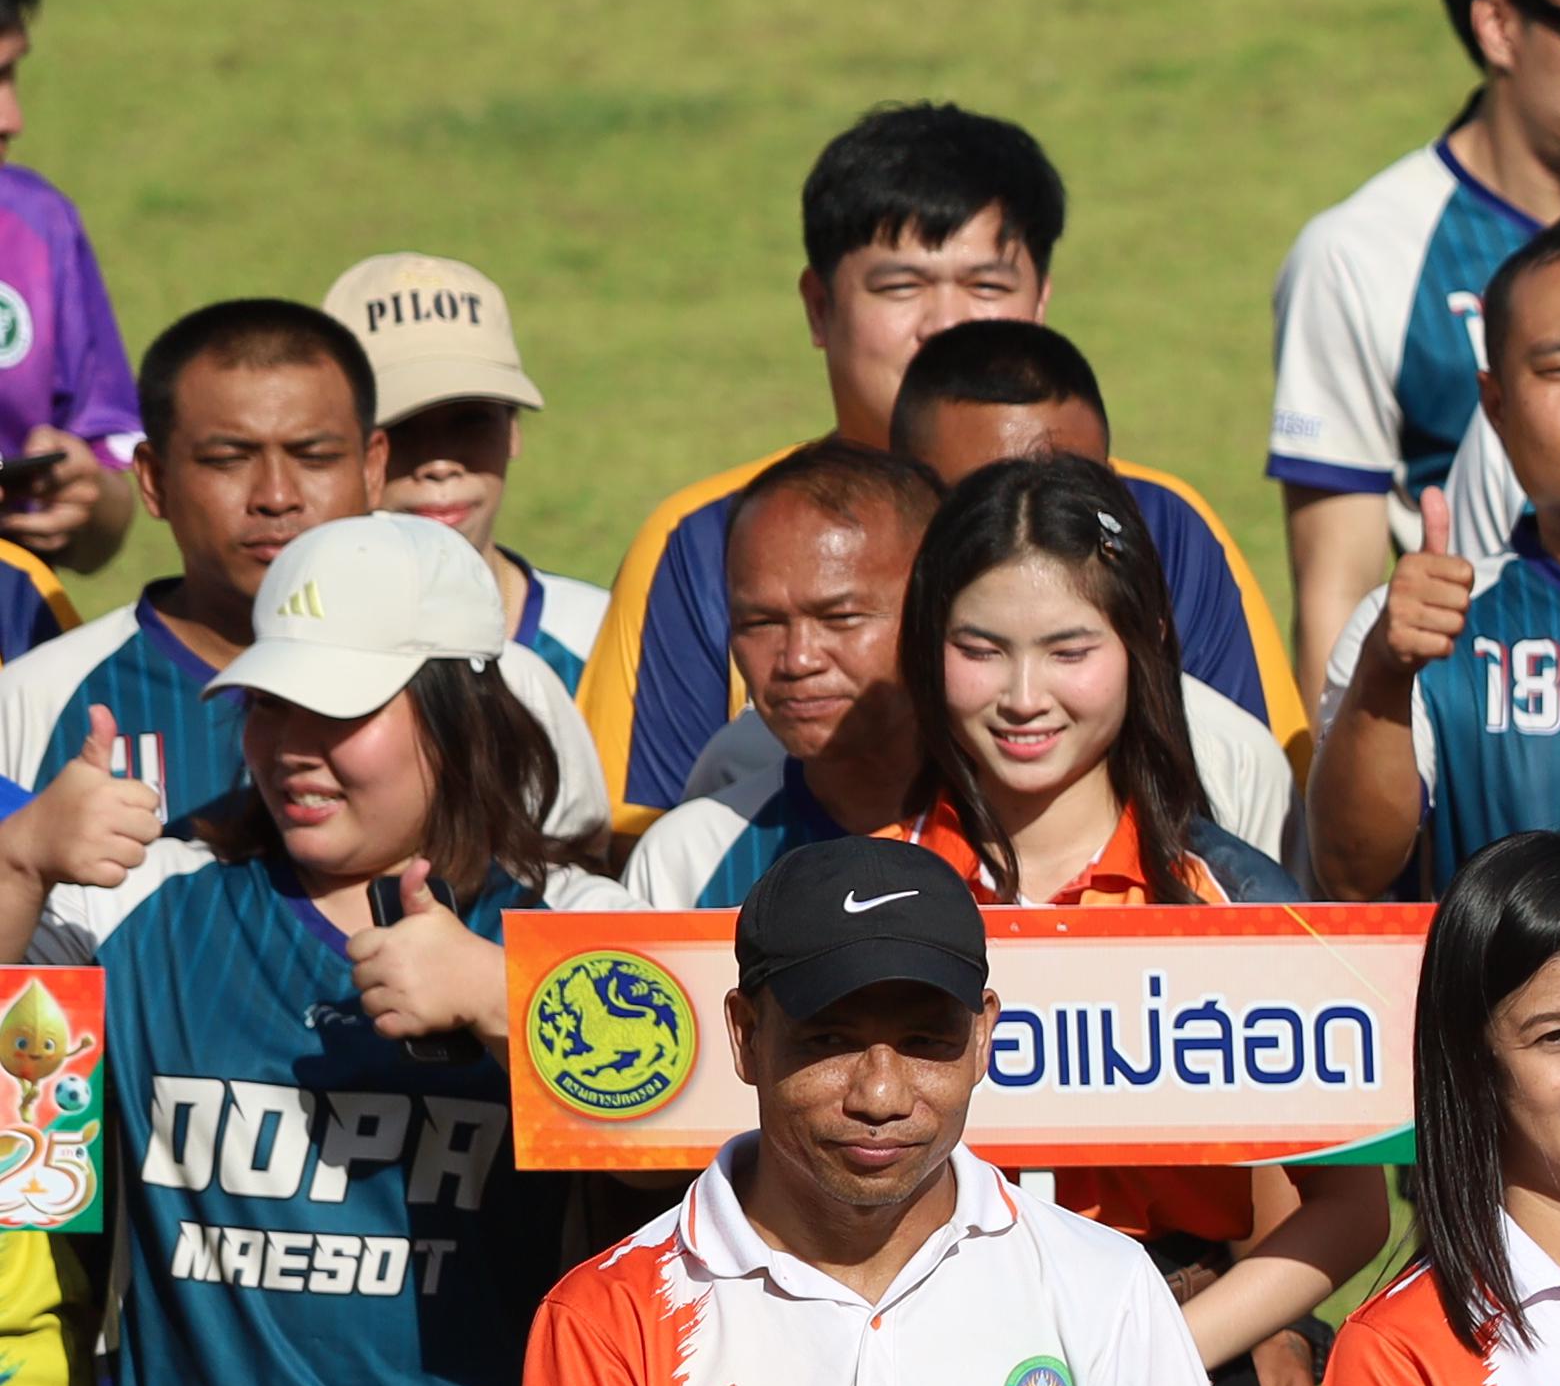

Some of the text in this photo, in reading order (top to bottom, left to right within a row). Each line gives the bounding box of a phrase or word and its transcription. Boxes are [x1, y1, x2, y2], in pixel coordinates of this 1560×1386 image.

[366, 284, 481, 334] PILOT
[142, 1075, 508, 1213] DOPA
[171, 1221, 457, 1297] MAESOT
